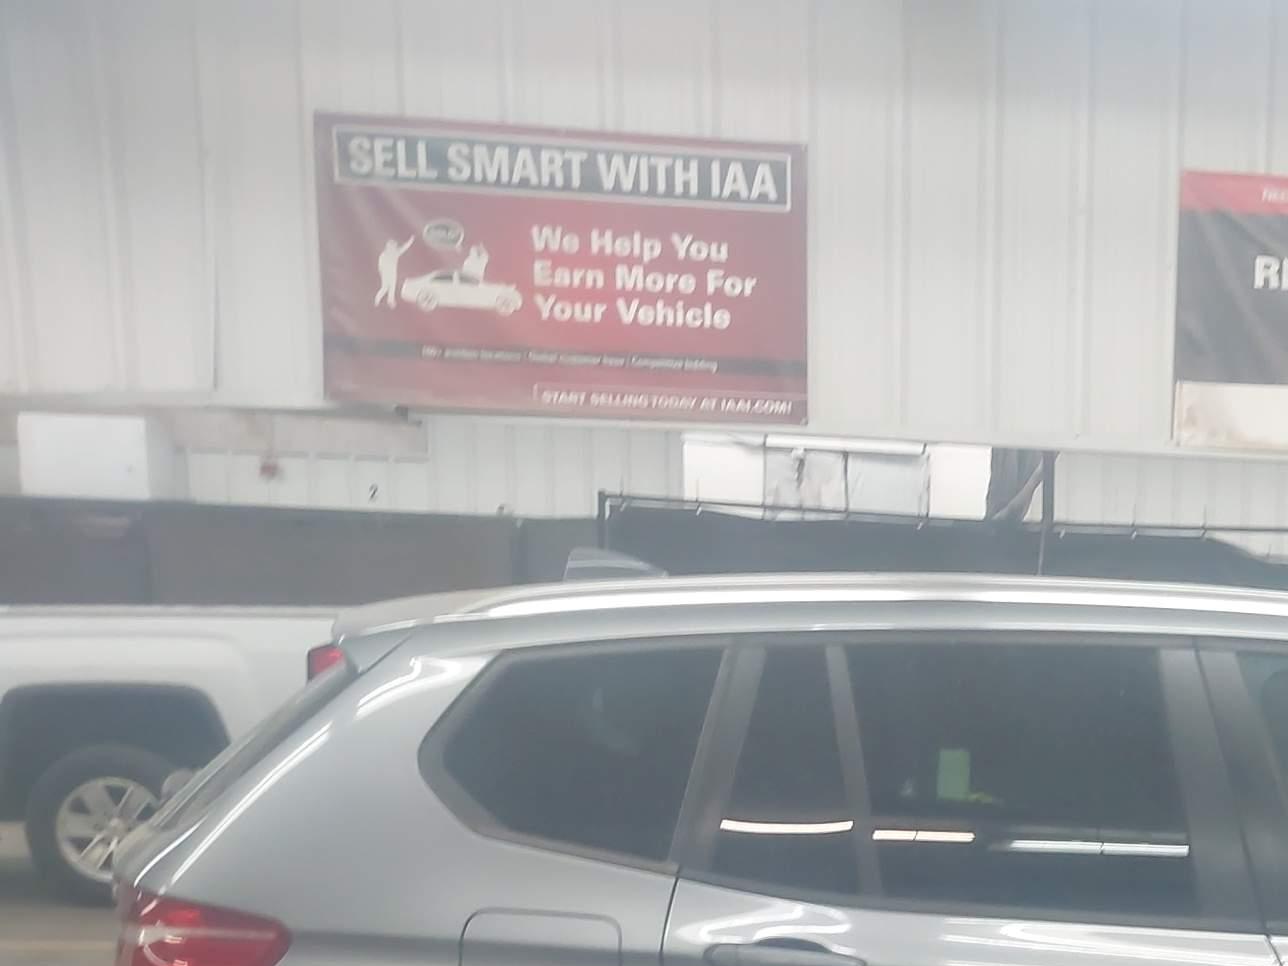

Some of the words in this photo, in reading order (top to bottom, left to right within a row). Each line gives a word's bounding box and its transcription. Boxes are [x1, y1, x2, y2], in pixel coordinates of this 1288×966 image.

[349, 136, 438, 181] SELL
[447, 142, 588, 190] SMART
[597, 151, 699, 197] WITH
[710, 157, 778, 202] IAA
[531, 224, 580, 255] We
[590, 228, 662, 264] Help
[672, 232, 729, 263] You
[532, 259, 605, 290] Earn
[615, 264, 696, 295] More
[706, 268, 758, 298] For
[534, 293, 607, 323] Your
[616, 297, 731, 330] Vehicle
[541, 390, 586, 407] START
[590, 392, 649, 409] SELLING
[651, 394, 698, 411] TODAY
[700, 396, 717, 411] AT
